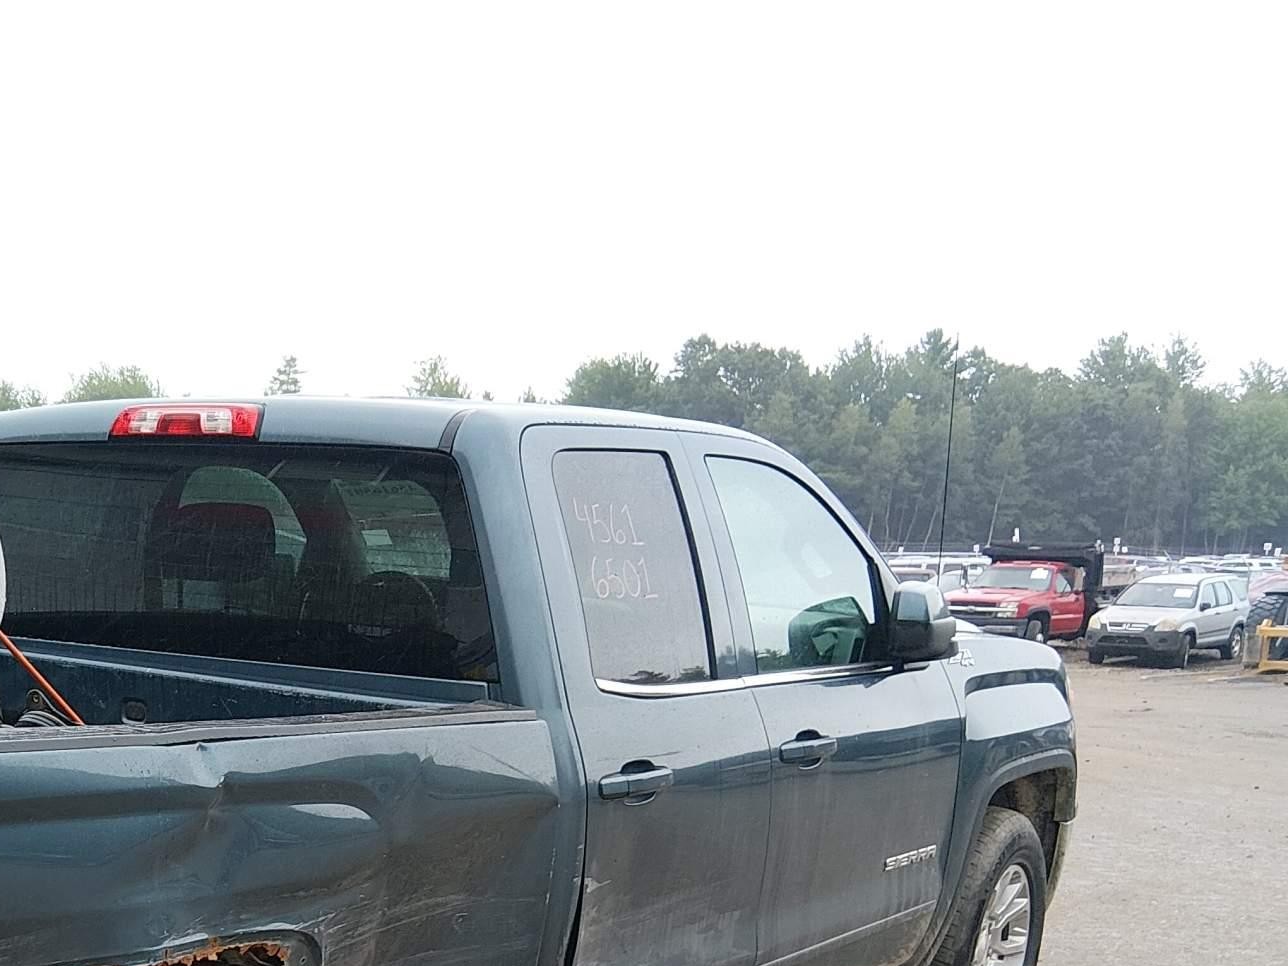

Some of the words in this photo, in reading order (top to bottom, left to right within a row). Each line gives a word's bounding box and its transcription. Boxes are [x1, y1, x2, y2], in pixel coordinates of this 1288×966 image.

[572, 497, 645, 546] 4561
[591, 556, 658, 599] 6501
[883, 844, 937, 871] SIERRA
